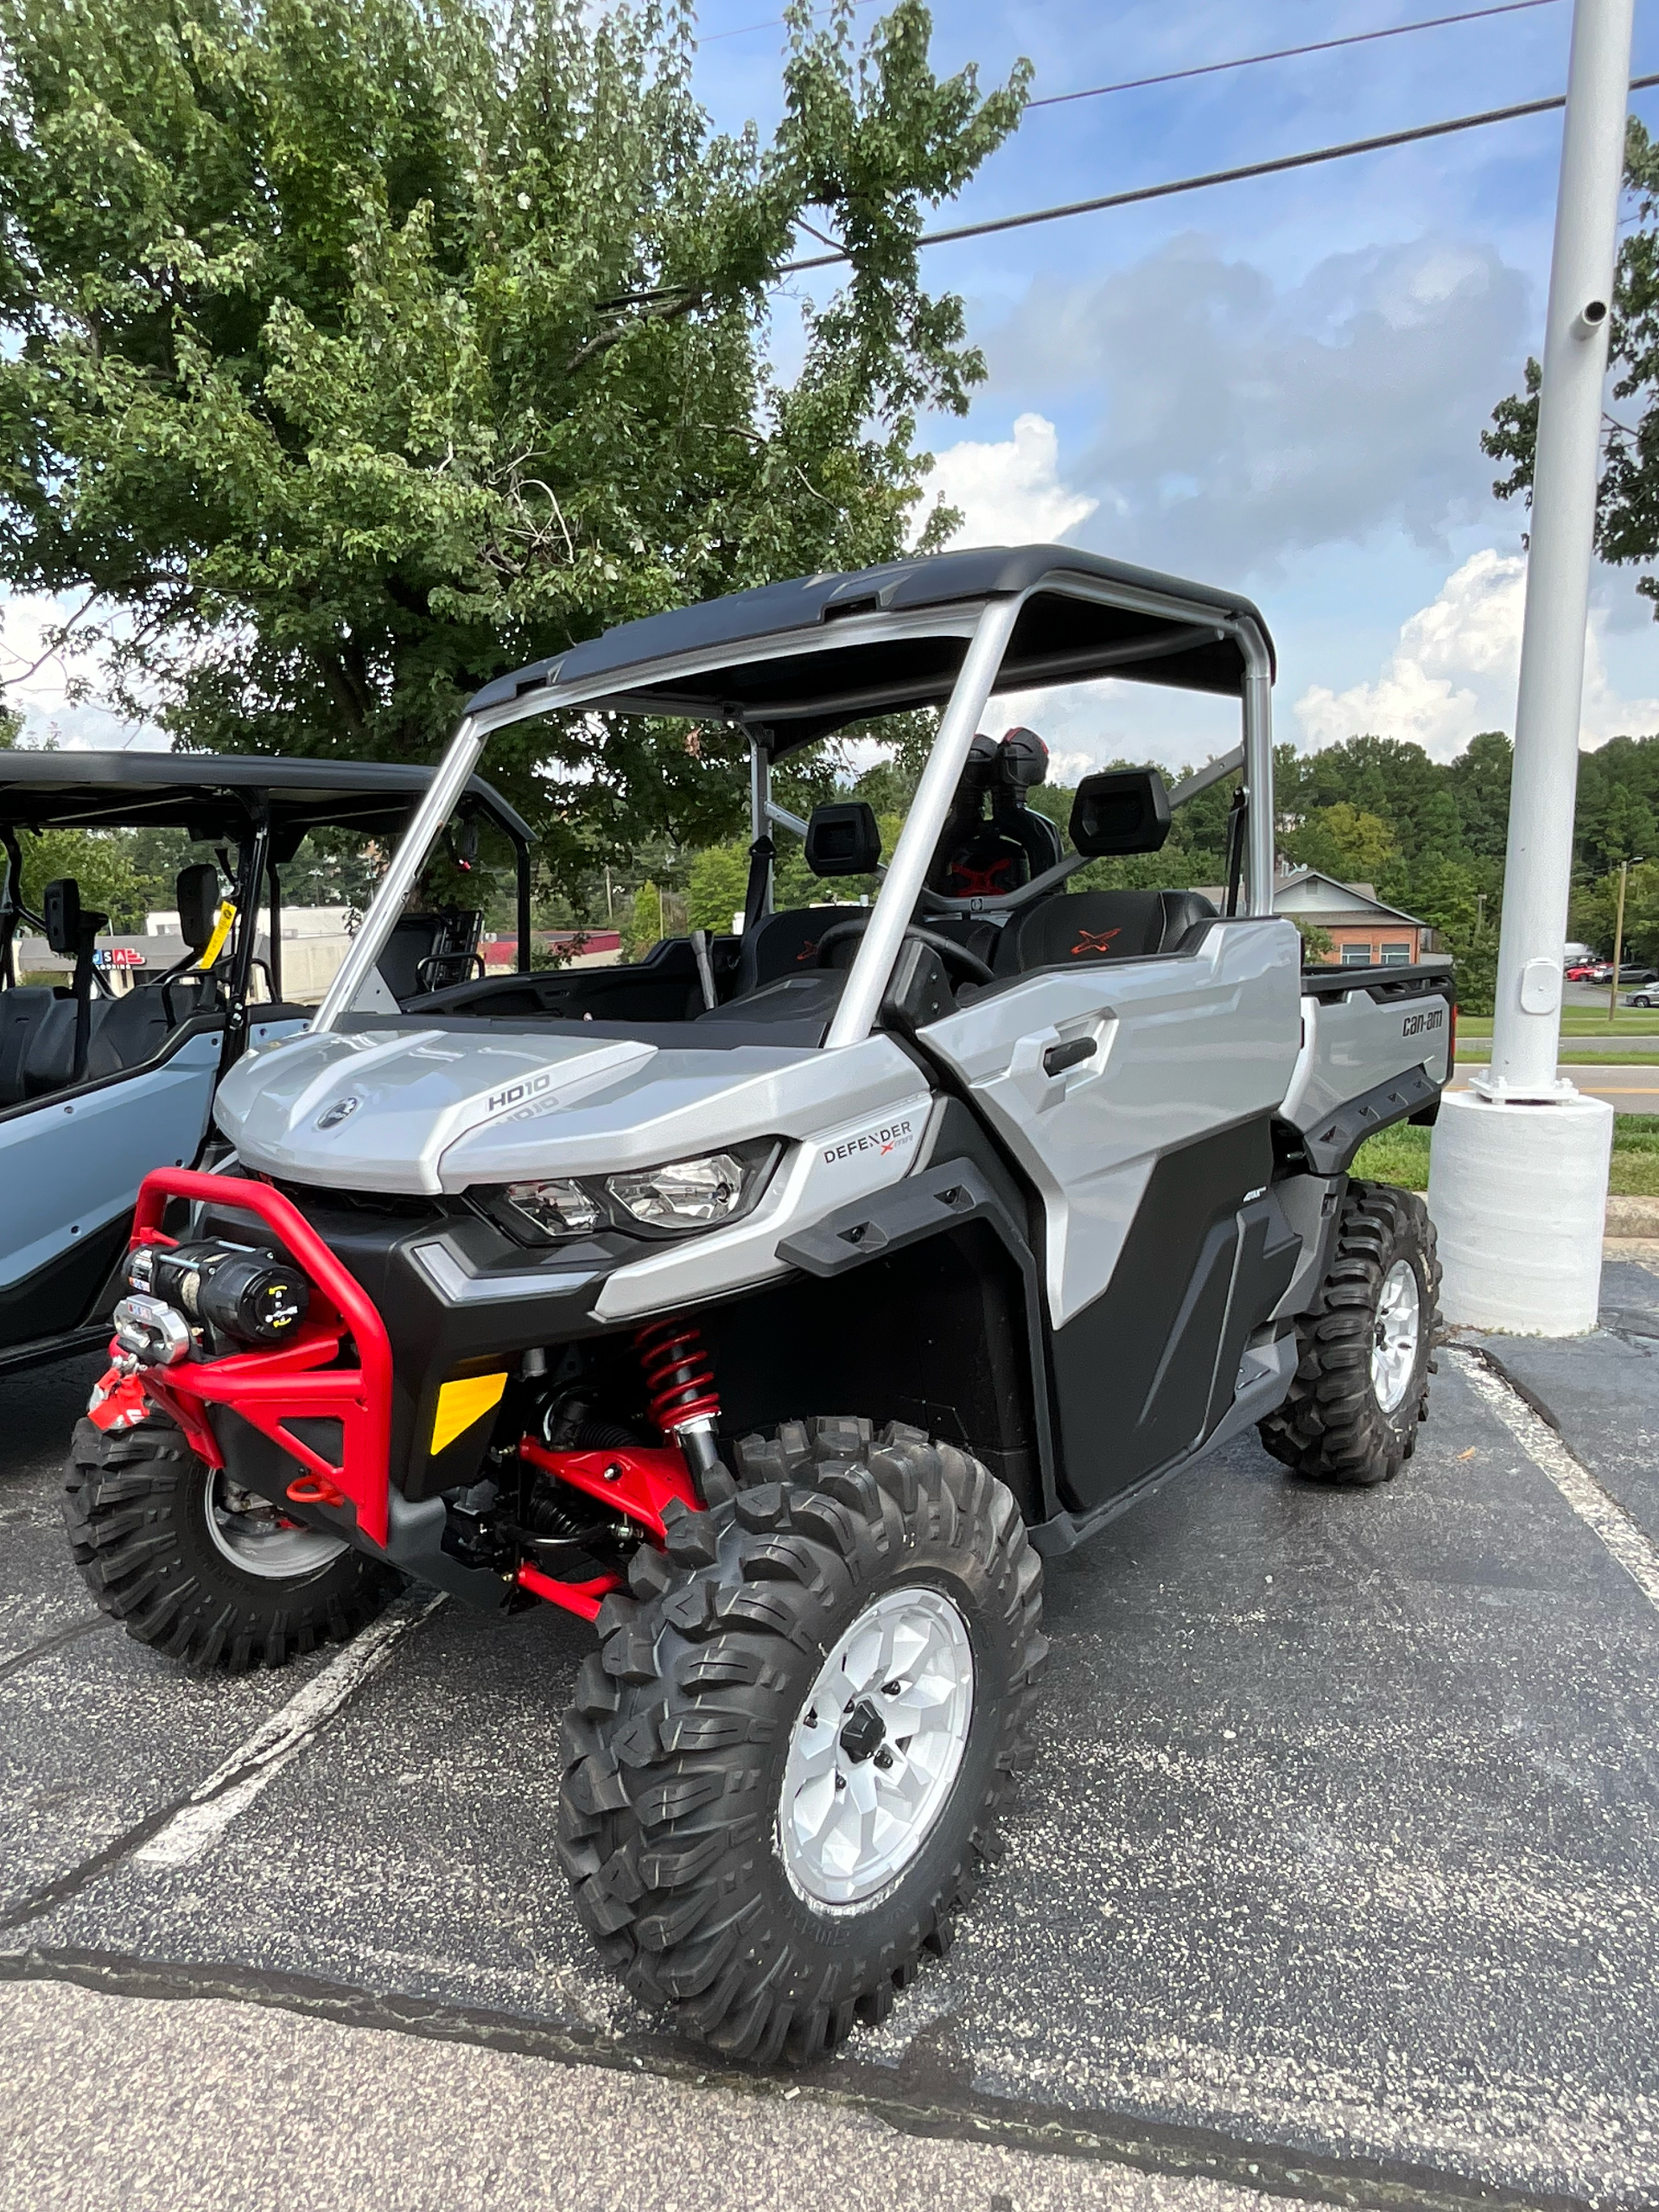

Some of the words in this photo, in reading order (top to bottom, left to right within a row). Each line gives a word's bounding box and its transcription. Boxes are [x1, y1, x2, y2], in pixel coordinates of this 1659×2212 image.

[1402, 1009, 1443, 1037] can-am
[488, 1074, 550, 1112] HD10
[823, 1121, 912, 1164] DEFENDER
